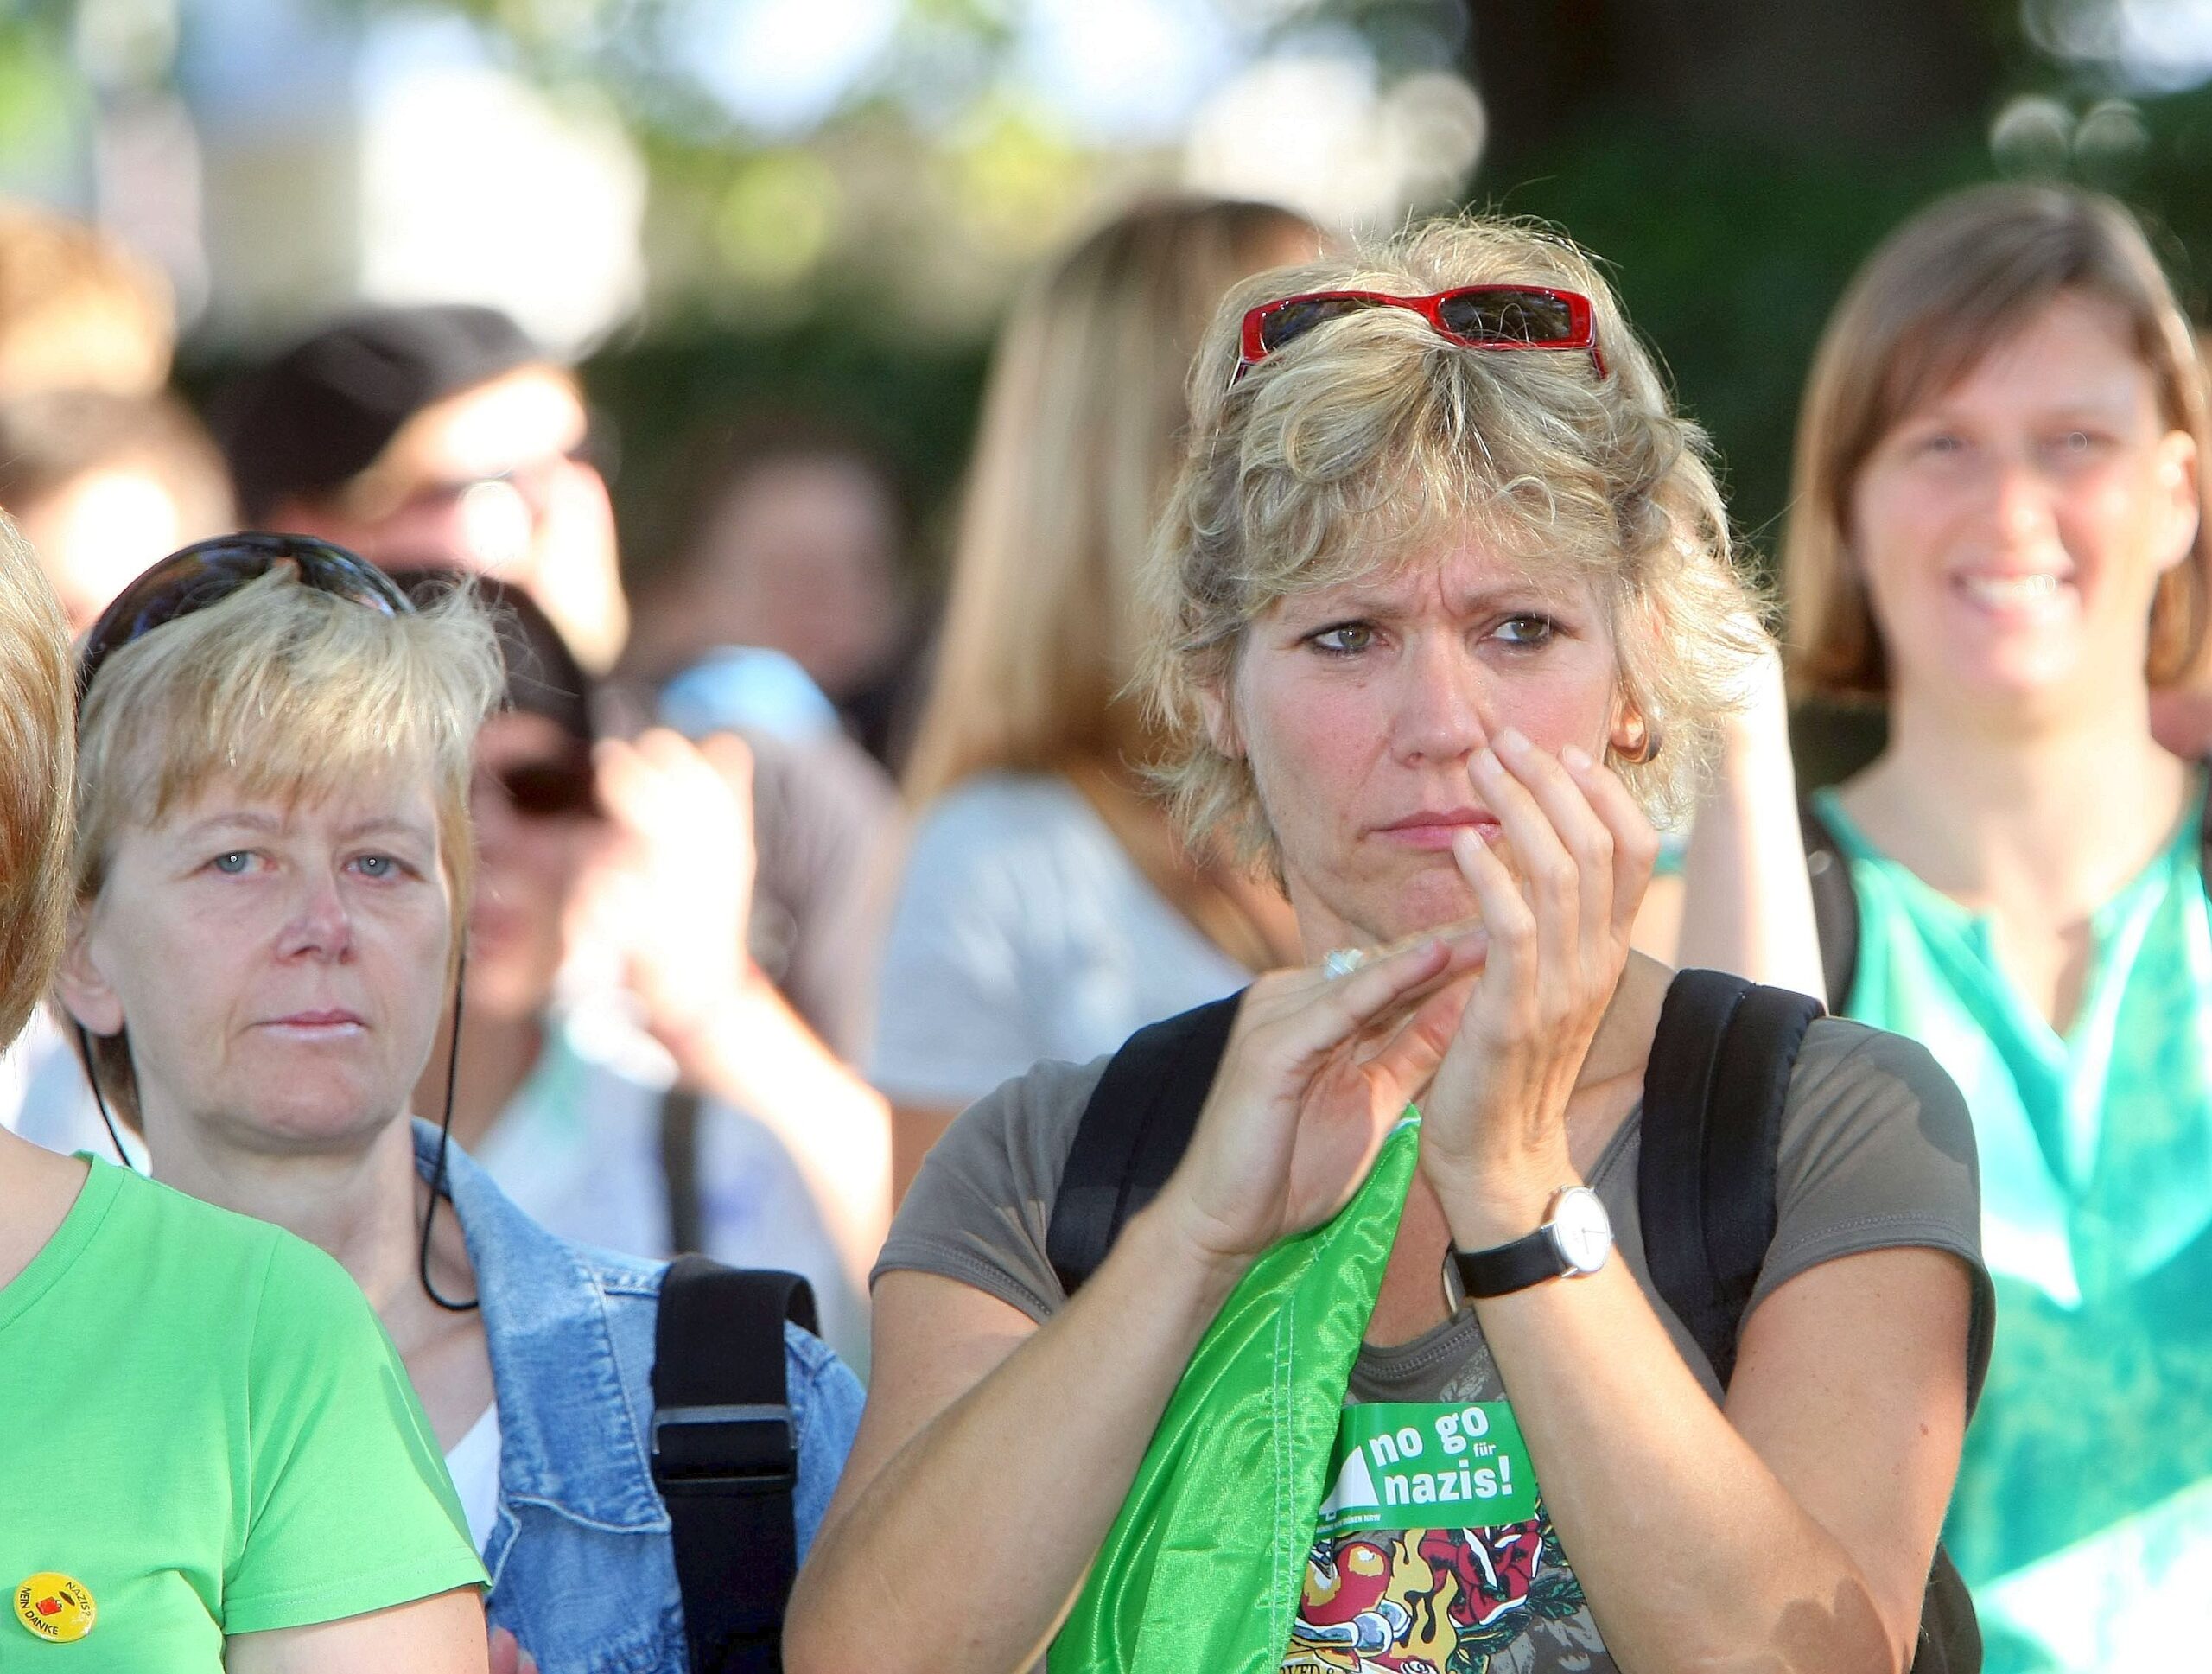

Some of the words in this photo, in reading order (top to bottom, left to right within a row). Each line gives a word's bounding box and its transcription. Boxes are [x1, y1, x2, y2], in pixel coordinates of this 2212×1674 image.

[1369, 1427, 1423, 1467] no
[1435, 1406, 1489, 1454] go
[1473, 1443, 1496, 1457] für
[1385, 1456, 1513, 1505] nazis!
[20, 1587, 32, 1609] NEIN
[66, 1582, 91, 1617] NAZIS?
[24, 1610, 59, 1635] DANKE
